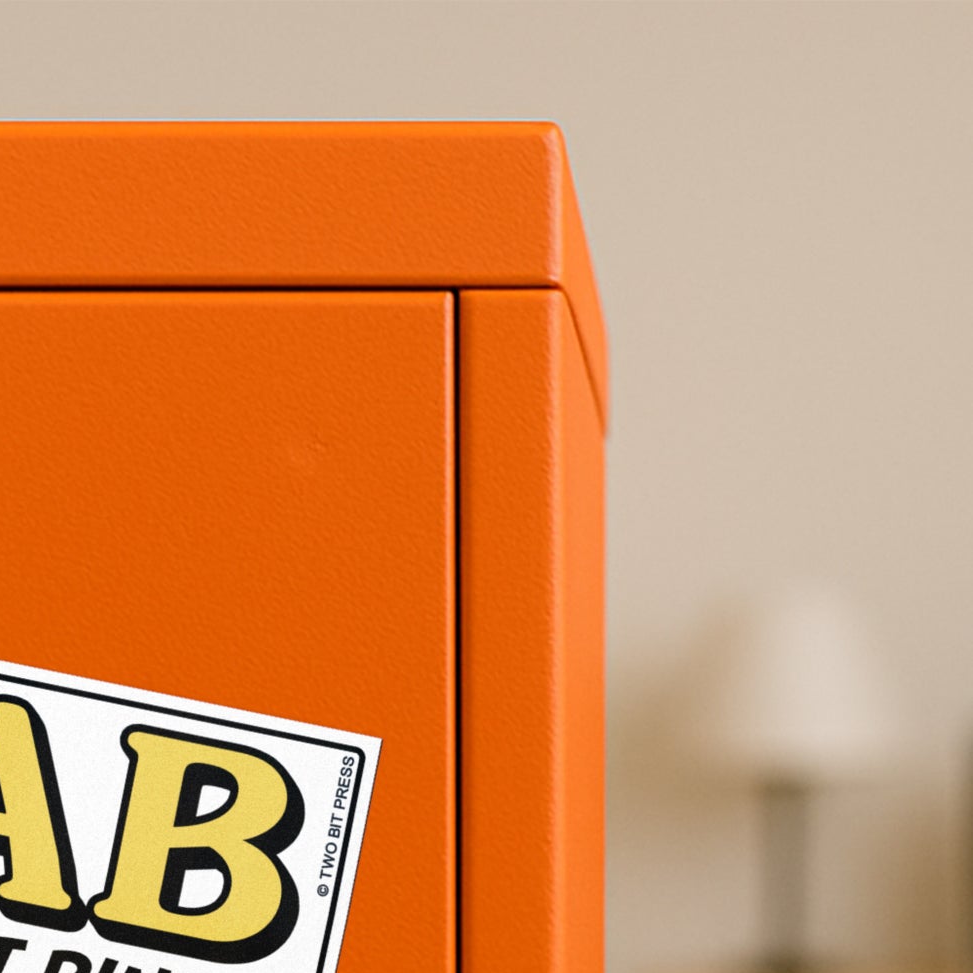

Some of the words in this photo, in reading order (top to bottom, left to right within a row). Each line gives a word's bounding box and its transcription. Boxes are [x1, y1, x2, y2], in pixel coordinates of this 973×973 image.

[333, 755, 355, 810] PRESS
[328, 813, 343, 839] BIT
[319, 842, 338, 879] TWO
[317, 884, 330, 898] ©
